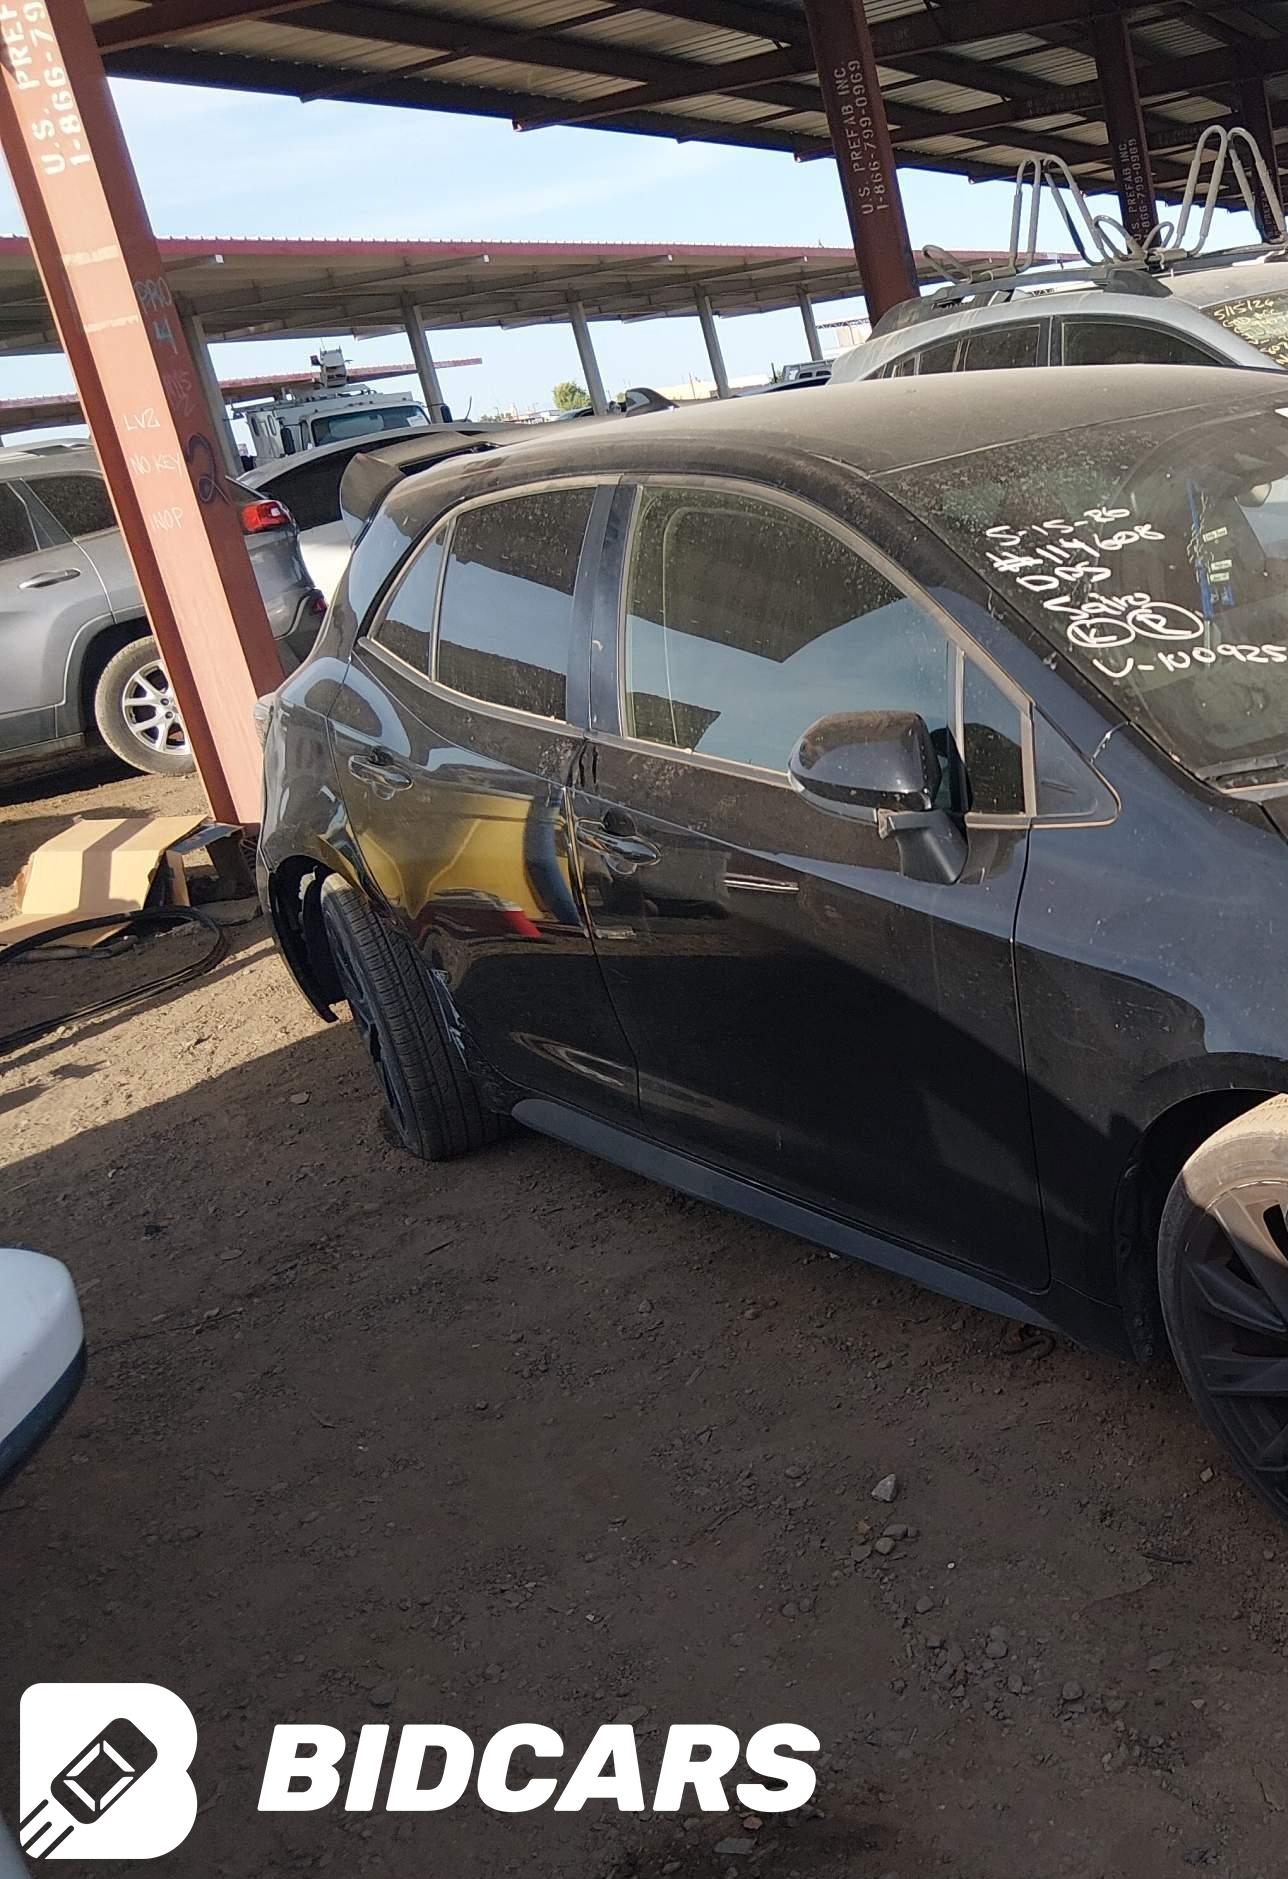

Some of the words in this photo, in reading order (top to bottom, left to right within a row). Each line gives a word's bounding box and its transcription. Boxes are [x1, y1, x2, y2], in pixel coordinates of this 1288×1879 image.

[32, 108, 66, 175] U.S.
[841, 104, 866, 172] PREFAB
[848, 60, 889, 210] 1-866-799-0969
[858, 180, 875, 215] U.S.
[1122, 167, 1138, 213] PREFAB
[155, 452, 183, 481] KEY
